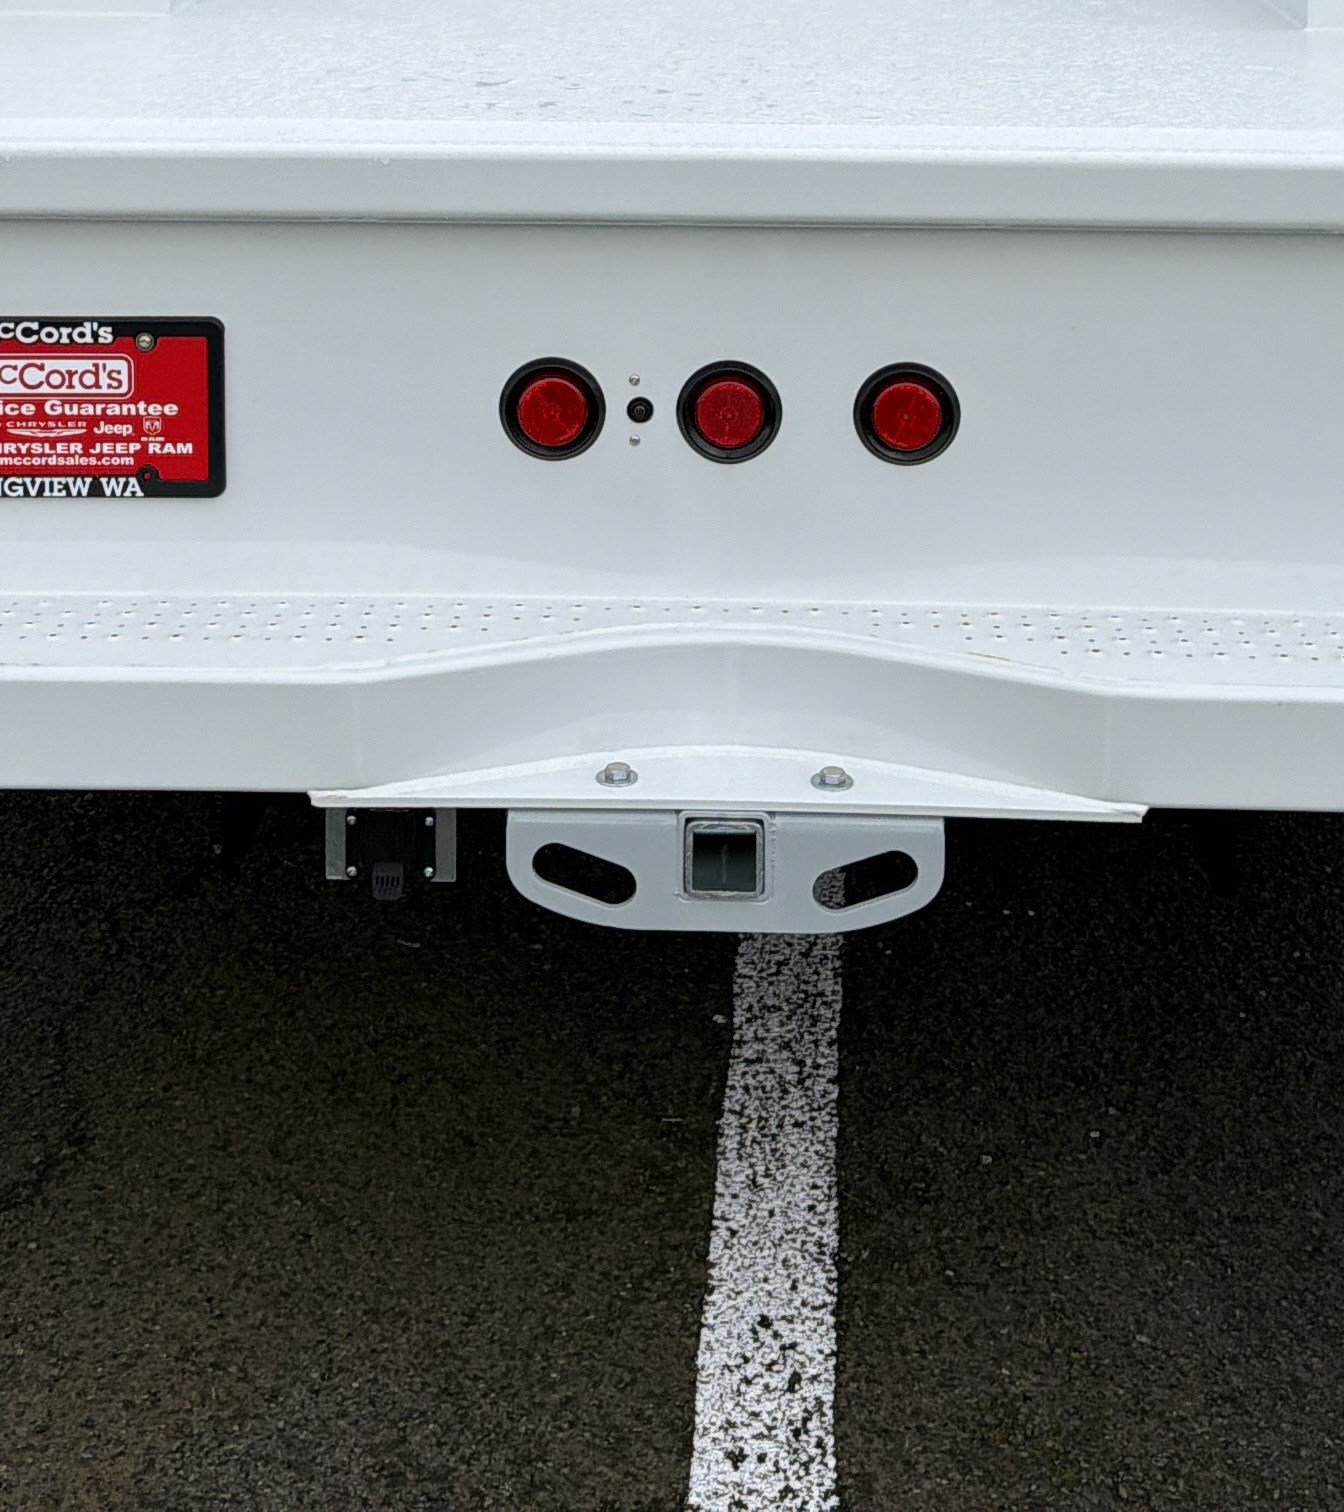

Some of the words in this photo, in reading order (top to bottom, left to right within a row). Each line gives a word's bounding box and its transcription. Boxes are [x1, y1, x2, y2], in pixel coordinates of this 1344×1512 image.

[44, 399, 179, 417] Guarantee
[5, 420, 87, 428] CHRYSLER
[93, 420, 133, 437] Jeep
[89, 442, 142, 455] JEEP
[147, 442, 194, 455] RAM
[101, 476, 145, 497] WA
